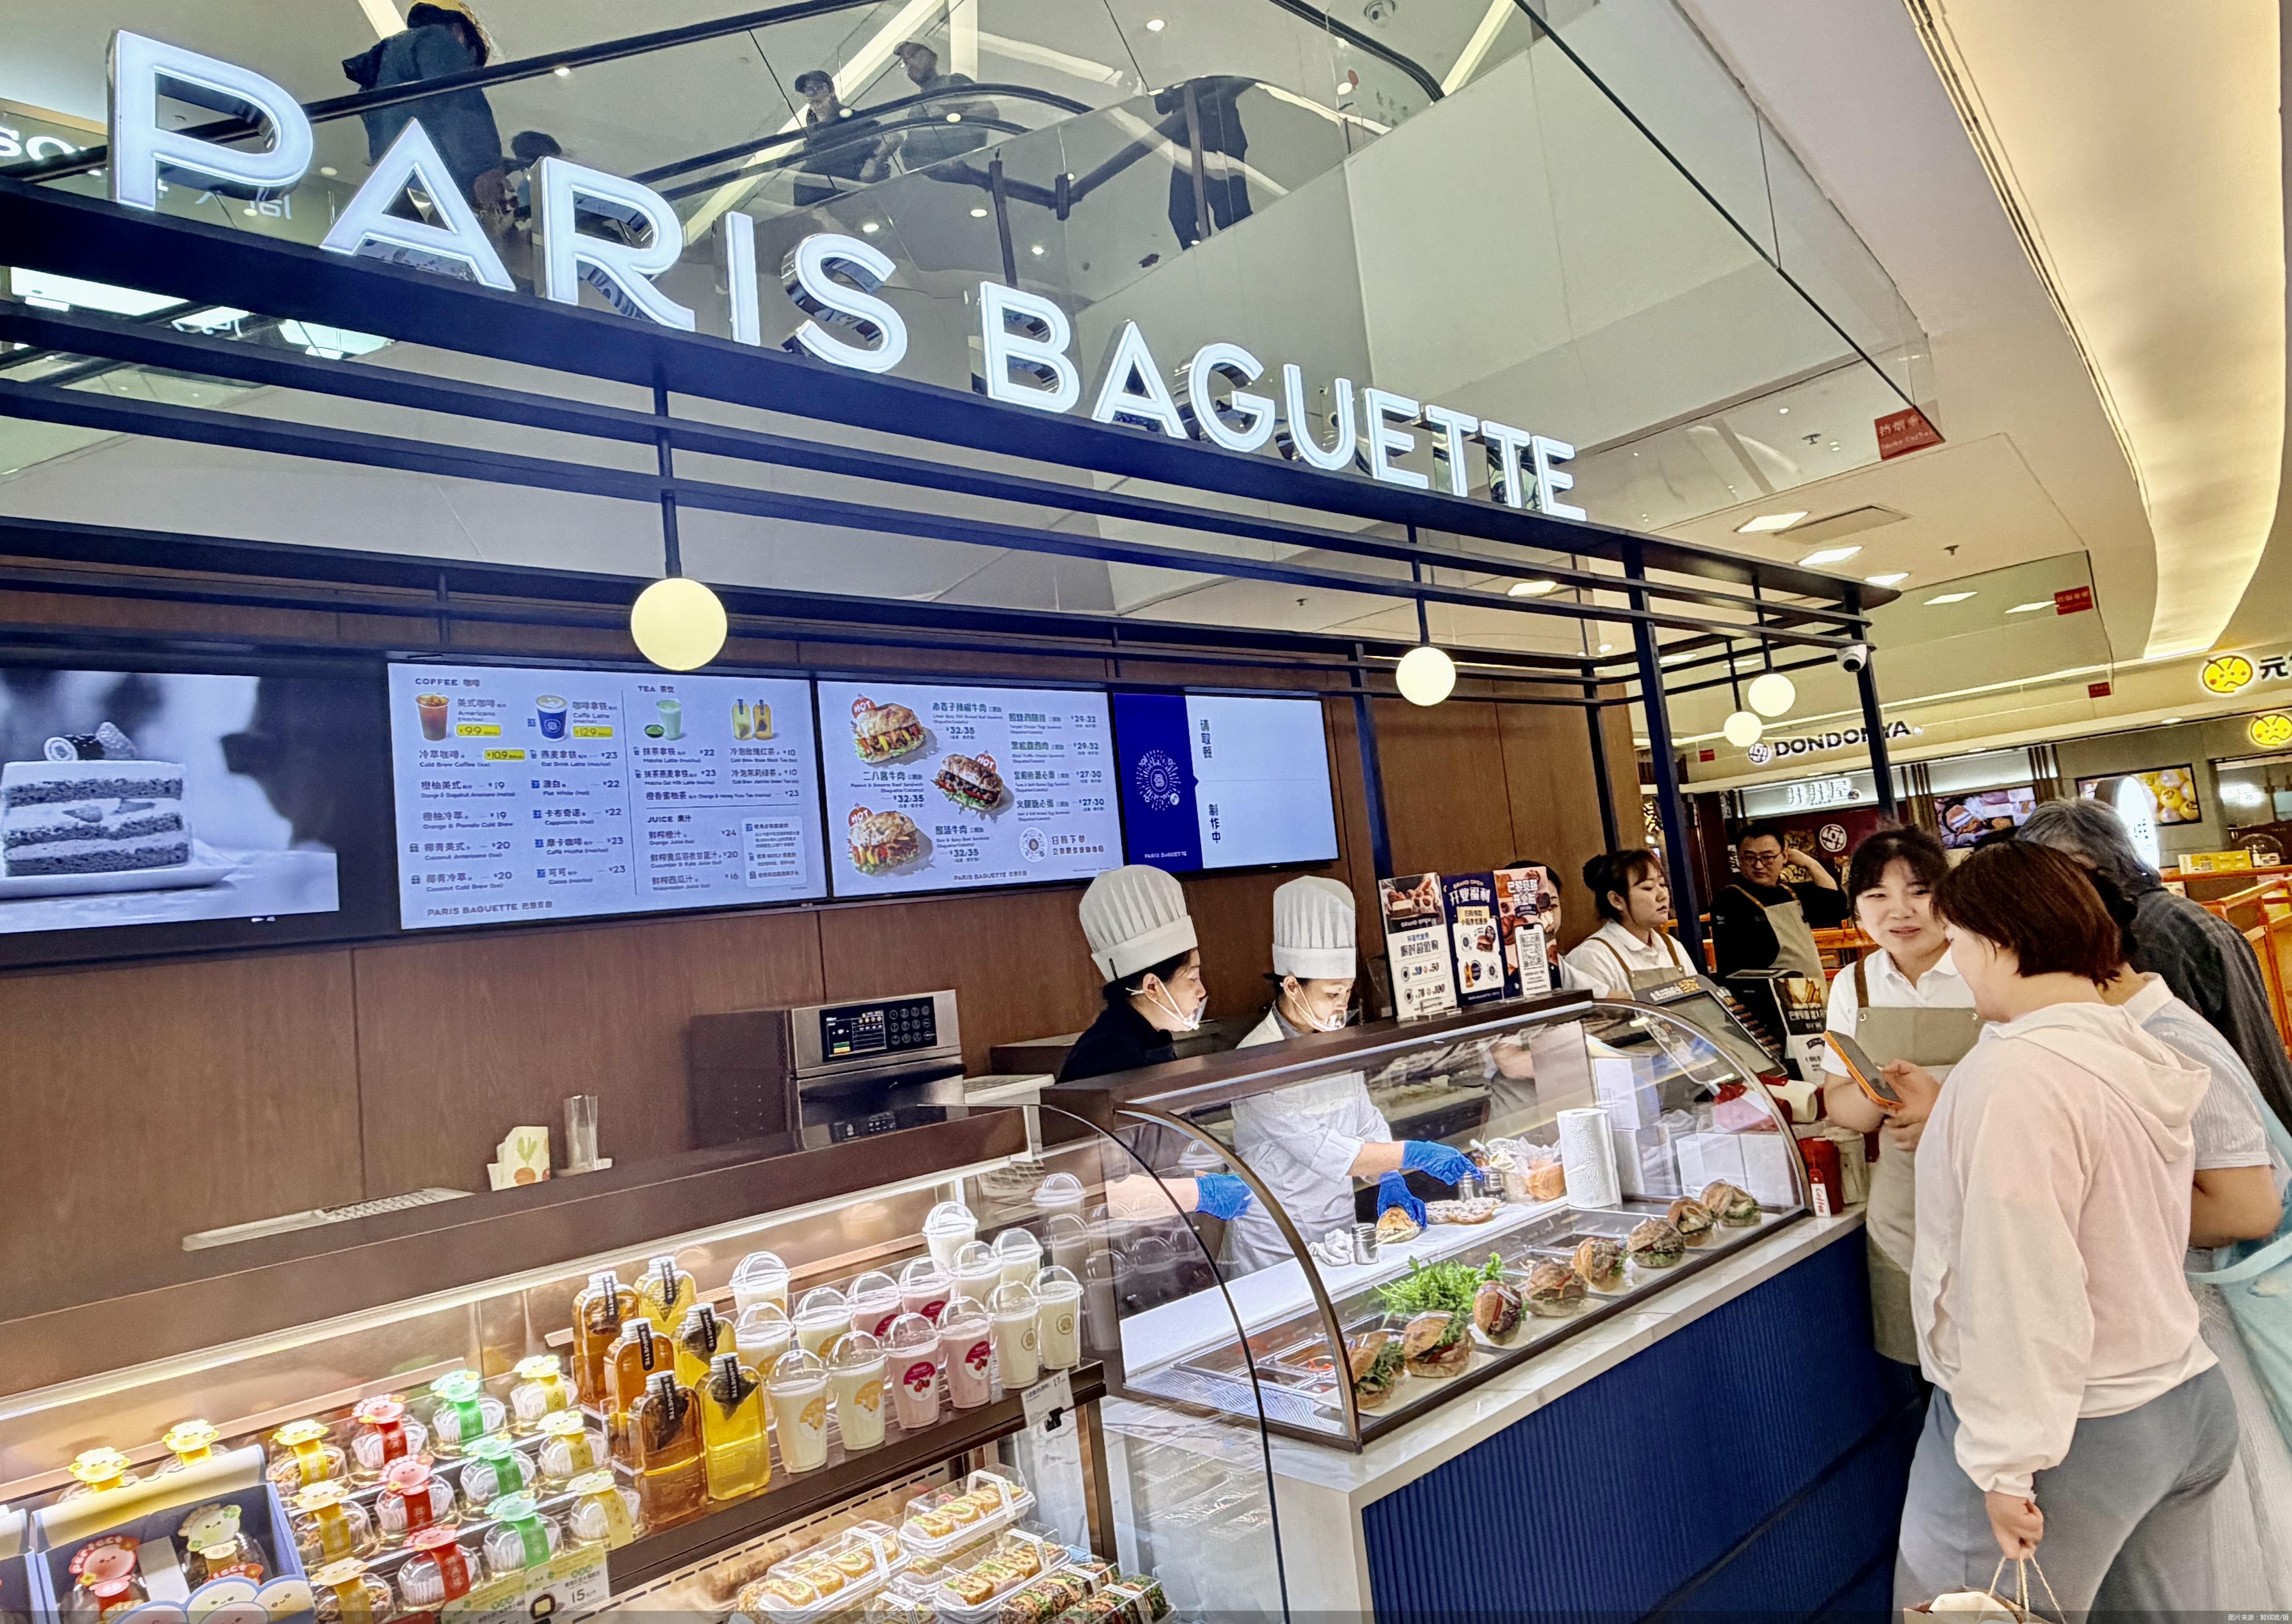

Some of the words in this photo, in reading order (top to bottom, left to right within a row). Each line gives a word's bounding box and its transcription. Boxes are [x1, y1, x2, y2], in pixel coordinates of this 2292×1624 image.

[115, 30, 908, 374] PARIS
[980, 281, 1587, 521] BAGUETTE
[2259, 653, 2292, 680] 元
[854, 702, 872, 712] HOT
[1775, 721, 1910, 756] DONDOYA
[977, 756, 994, 768] HOT
[851, 811, 869, 824] HOT
[1449, 887, 1490, 906] 开业福利
[427, 907, 459, 916] PARIS
[463, 903, 518, 914] BAGUETTE
[571, 1588, 585, 1603] 15
